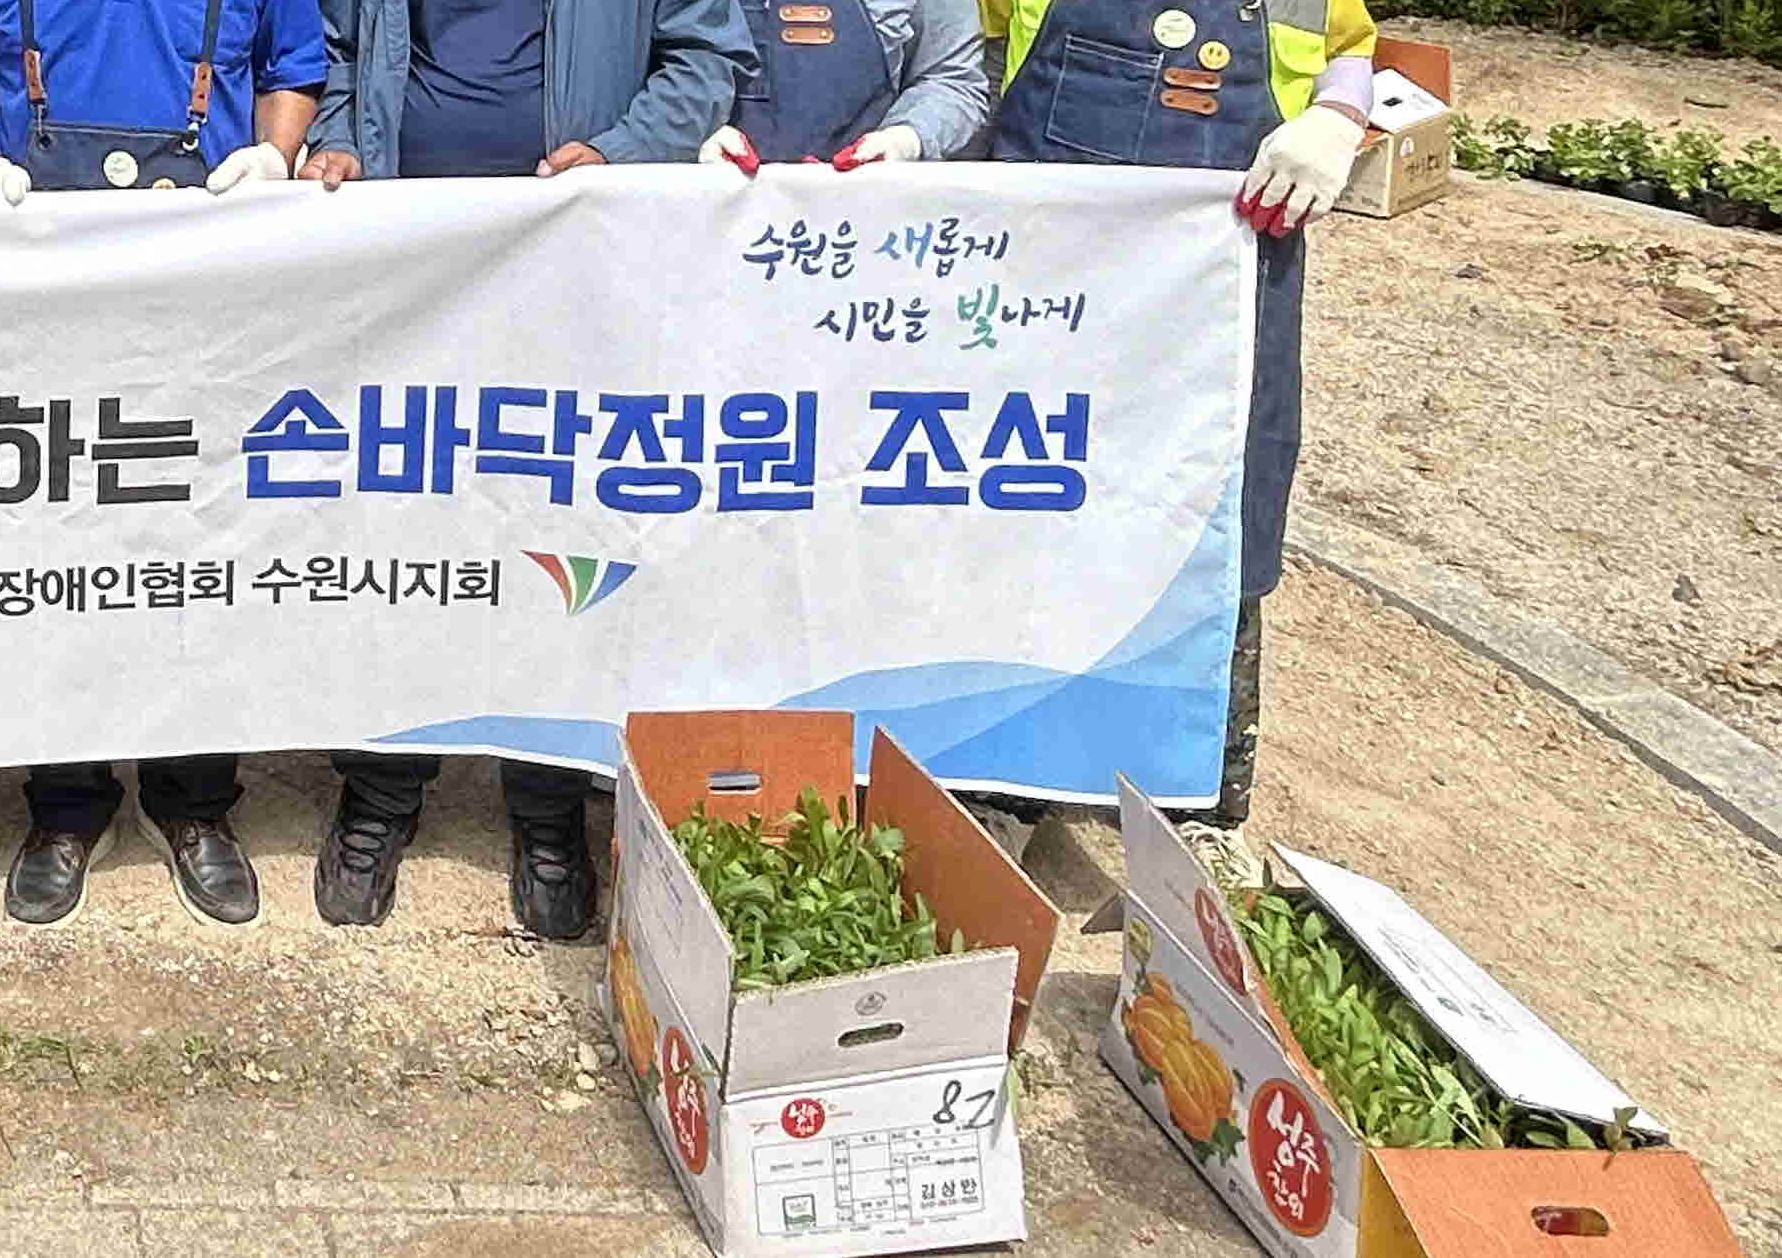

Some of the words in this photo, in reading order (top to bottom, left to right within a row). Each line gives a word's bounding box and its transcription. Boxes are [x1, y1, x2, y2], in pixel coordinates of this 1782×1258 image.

[743, 220, 859, 279] 수원을
[873, 217, 1010, 278] 새롭게
[813, 296, 931, 343] 시민을
[956, 284, 1087, 351] 빛나게
[241, 385, 819, 514] 손바닥정원
[860, 391, 1091, 512] 조성
[251, 555, 501, 607] 수원시지회
